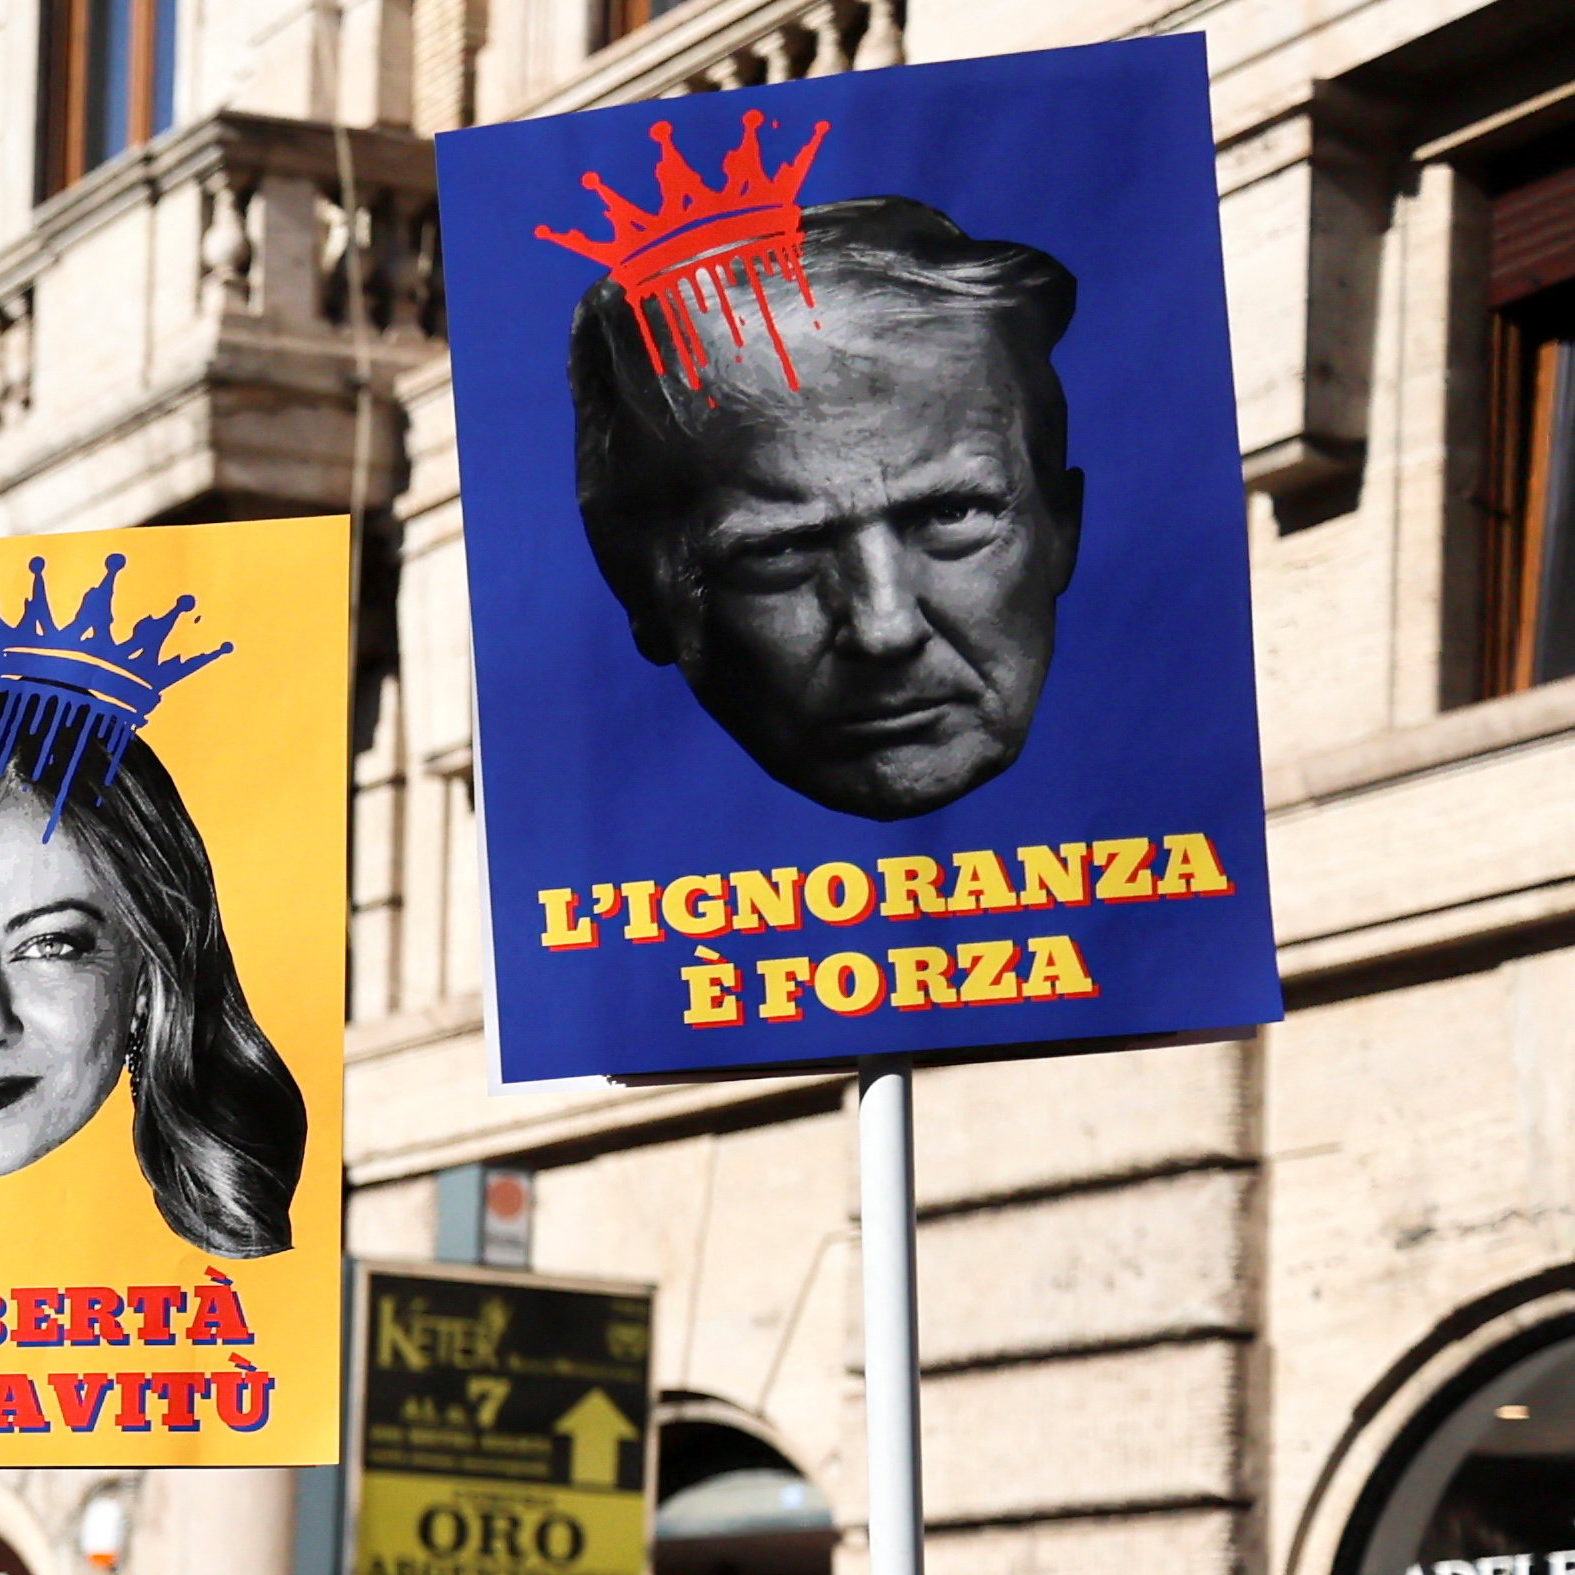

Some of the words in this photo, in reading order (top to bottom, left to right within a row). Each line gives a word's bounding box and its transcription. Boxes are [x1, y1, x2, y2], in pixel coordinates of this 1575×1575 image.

[537, 832, 1237, 949] L'IGNORANZA
[680, 945, 745, 1030] È
[756, 934, 1099, 1022] FORZA
[466, 1377, 511, 1428] 7
[418, 1505, 585, 1566] ORO
